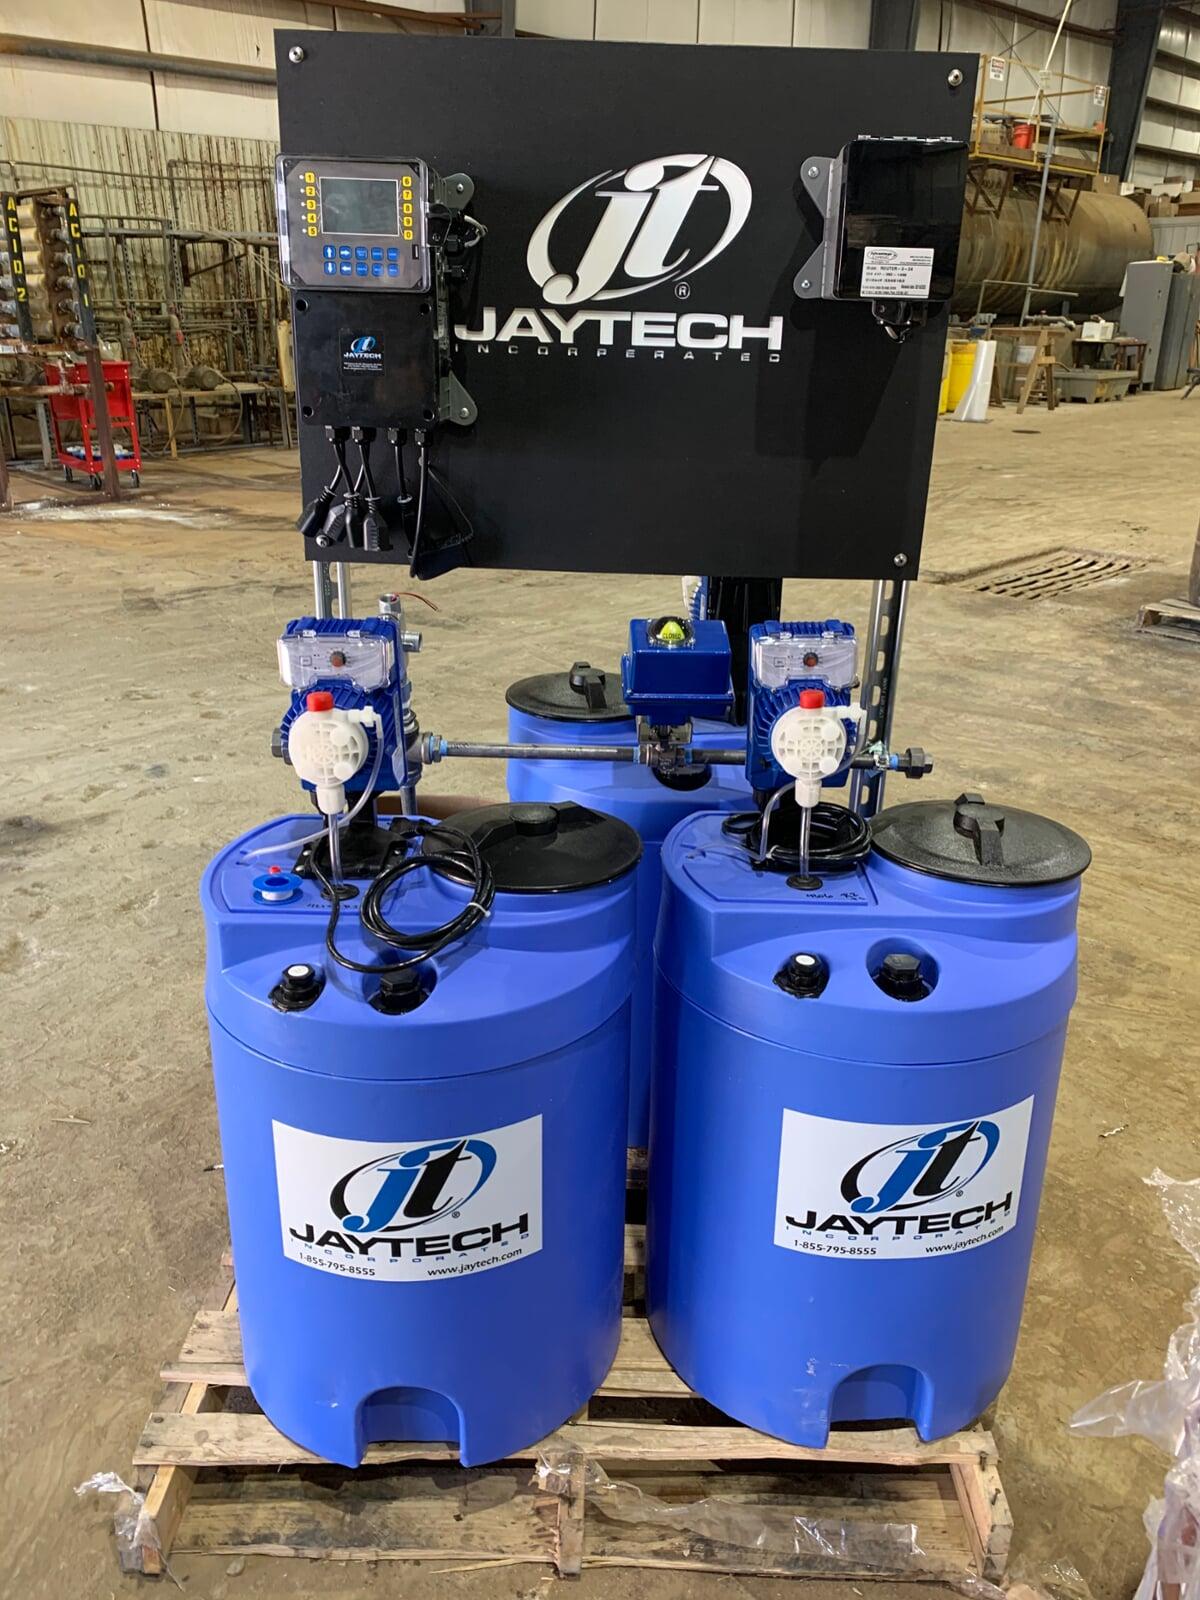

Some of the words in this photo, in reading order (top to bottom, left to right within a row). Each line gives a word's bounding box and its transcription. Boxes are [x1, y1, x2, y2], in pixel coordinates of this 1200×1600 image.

[7, 196, 22, 274] ACID
[16, 287, 26, 302] 2
[84, 293, 89, 307] 1
[453, 306, 783, 350] JAYTECH
[454, 343, 780, 363] INCORPERATED
[785, 1191, 1012, 1236] JAYTECH
[786, 1211, 1010, 1241] INCORPORATED
[289, 1212, 529, 1257] JAYTECH
[291, 1233, 529, 1263] INCORPORATED
[794, 1239, 877, 1256] 1-855-795-8555
[925, 1225, 1004, 1254] www.jaytech.com
[299, 1252, 376, 1277] 1-855-795-8555
[427, 1249, 522, 1277] www.jaytech.com
